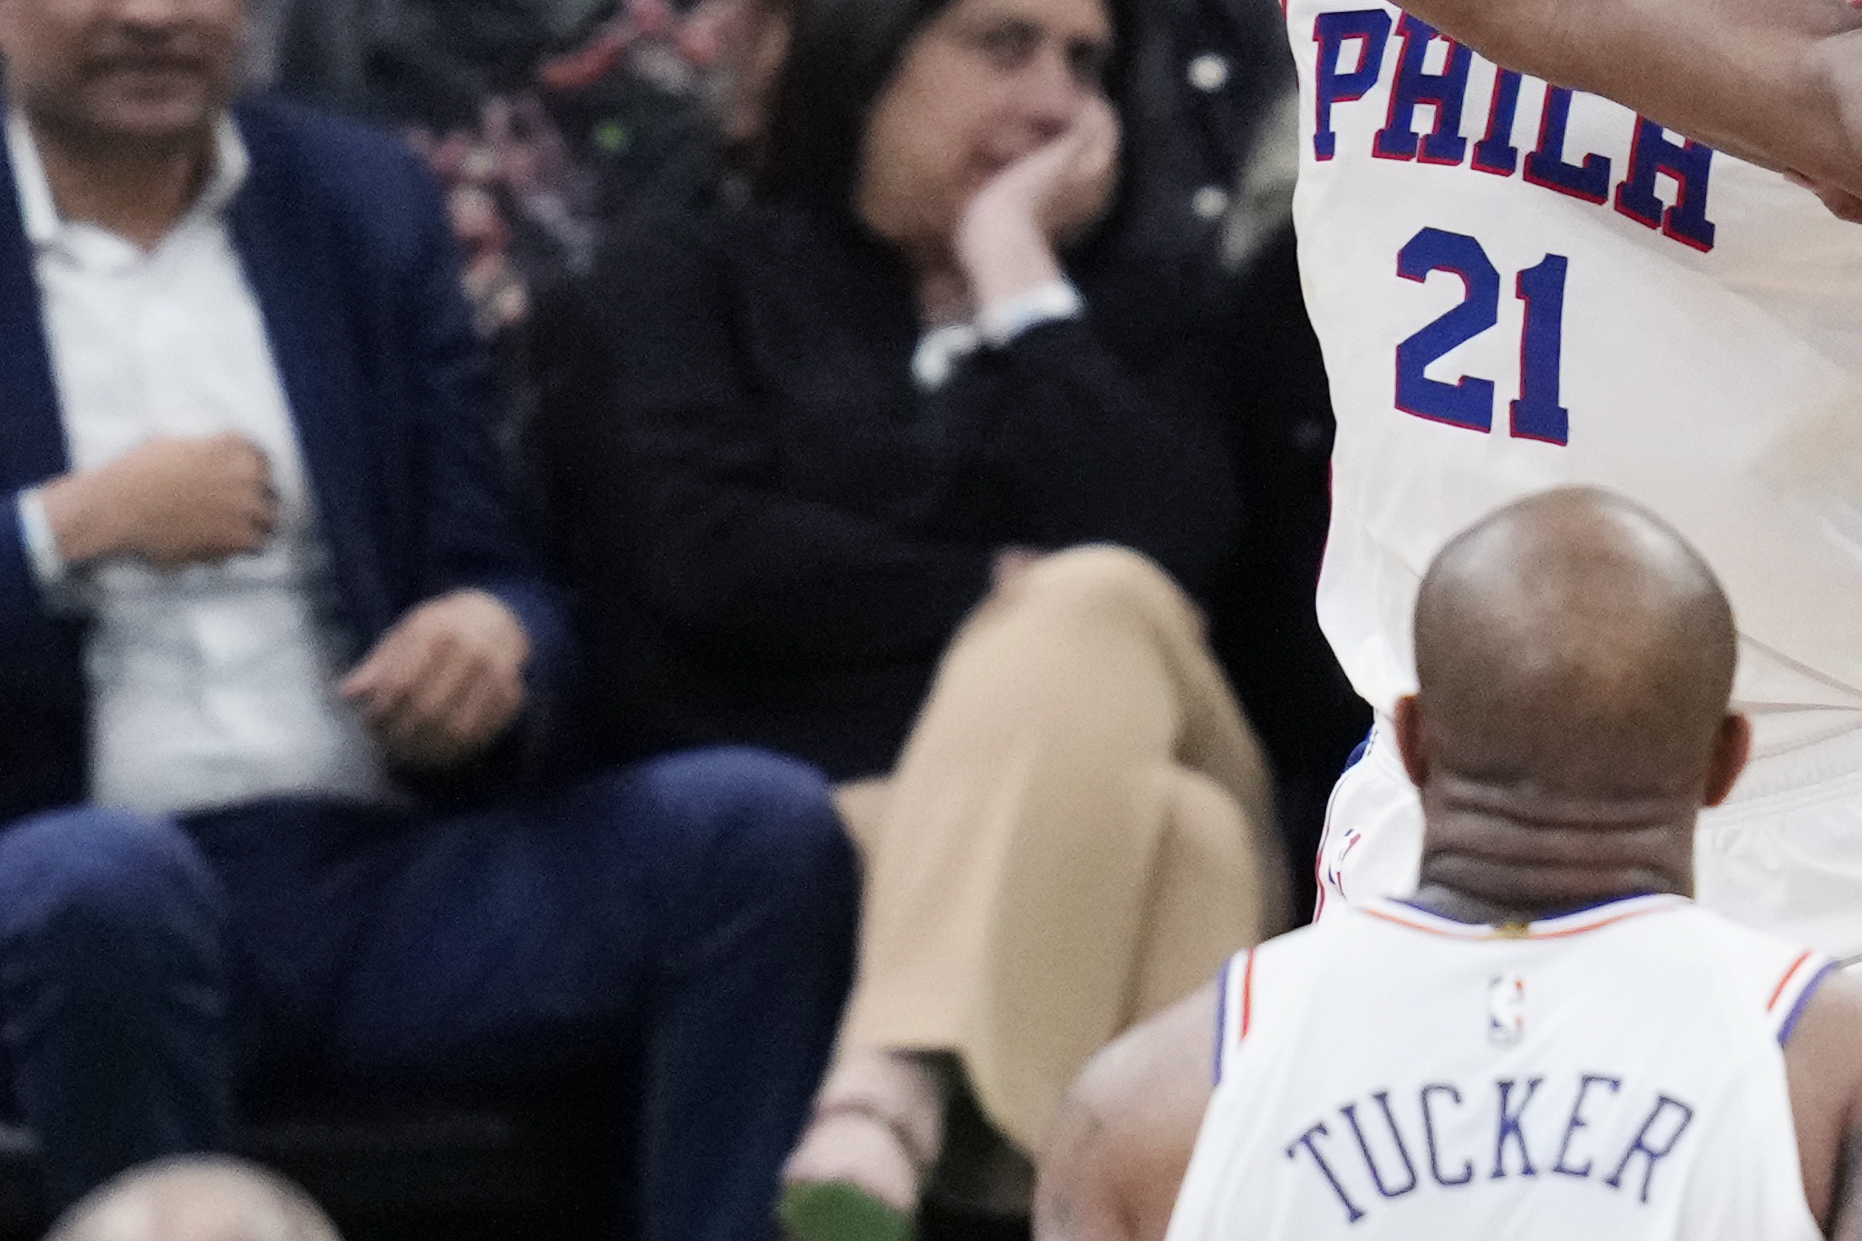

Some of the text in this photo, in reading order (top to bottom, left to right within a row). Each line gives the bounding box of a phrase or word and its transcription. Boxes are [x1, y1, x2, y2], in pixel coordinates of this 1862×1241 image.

[1313, 8, 1716, 254] PHILA
[1394, 226, 1569, 447] 21
[1285, 1073, 1694, 1225] TUCKER
